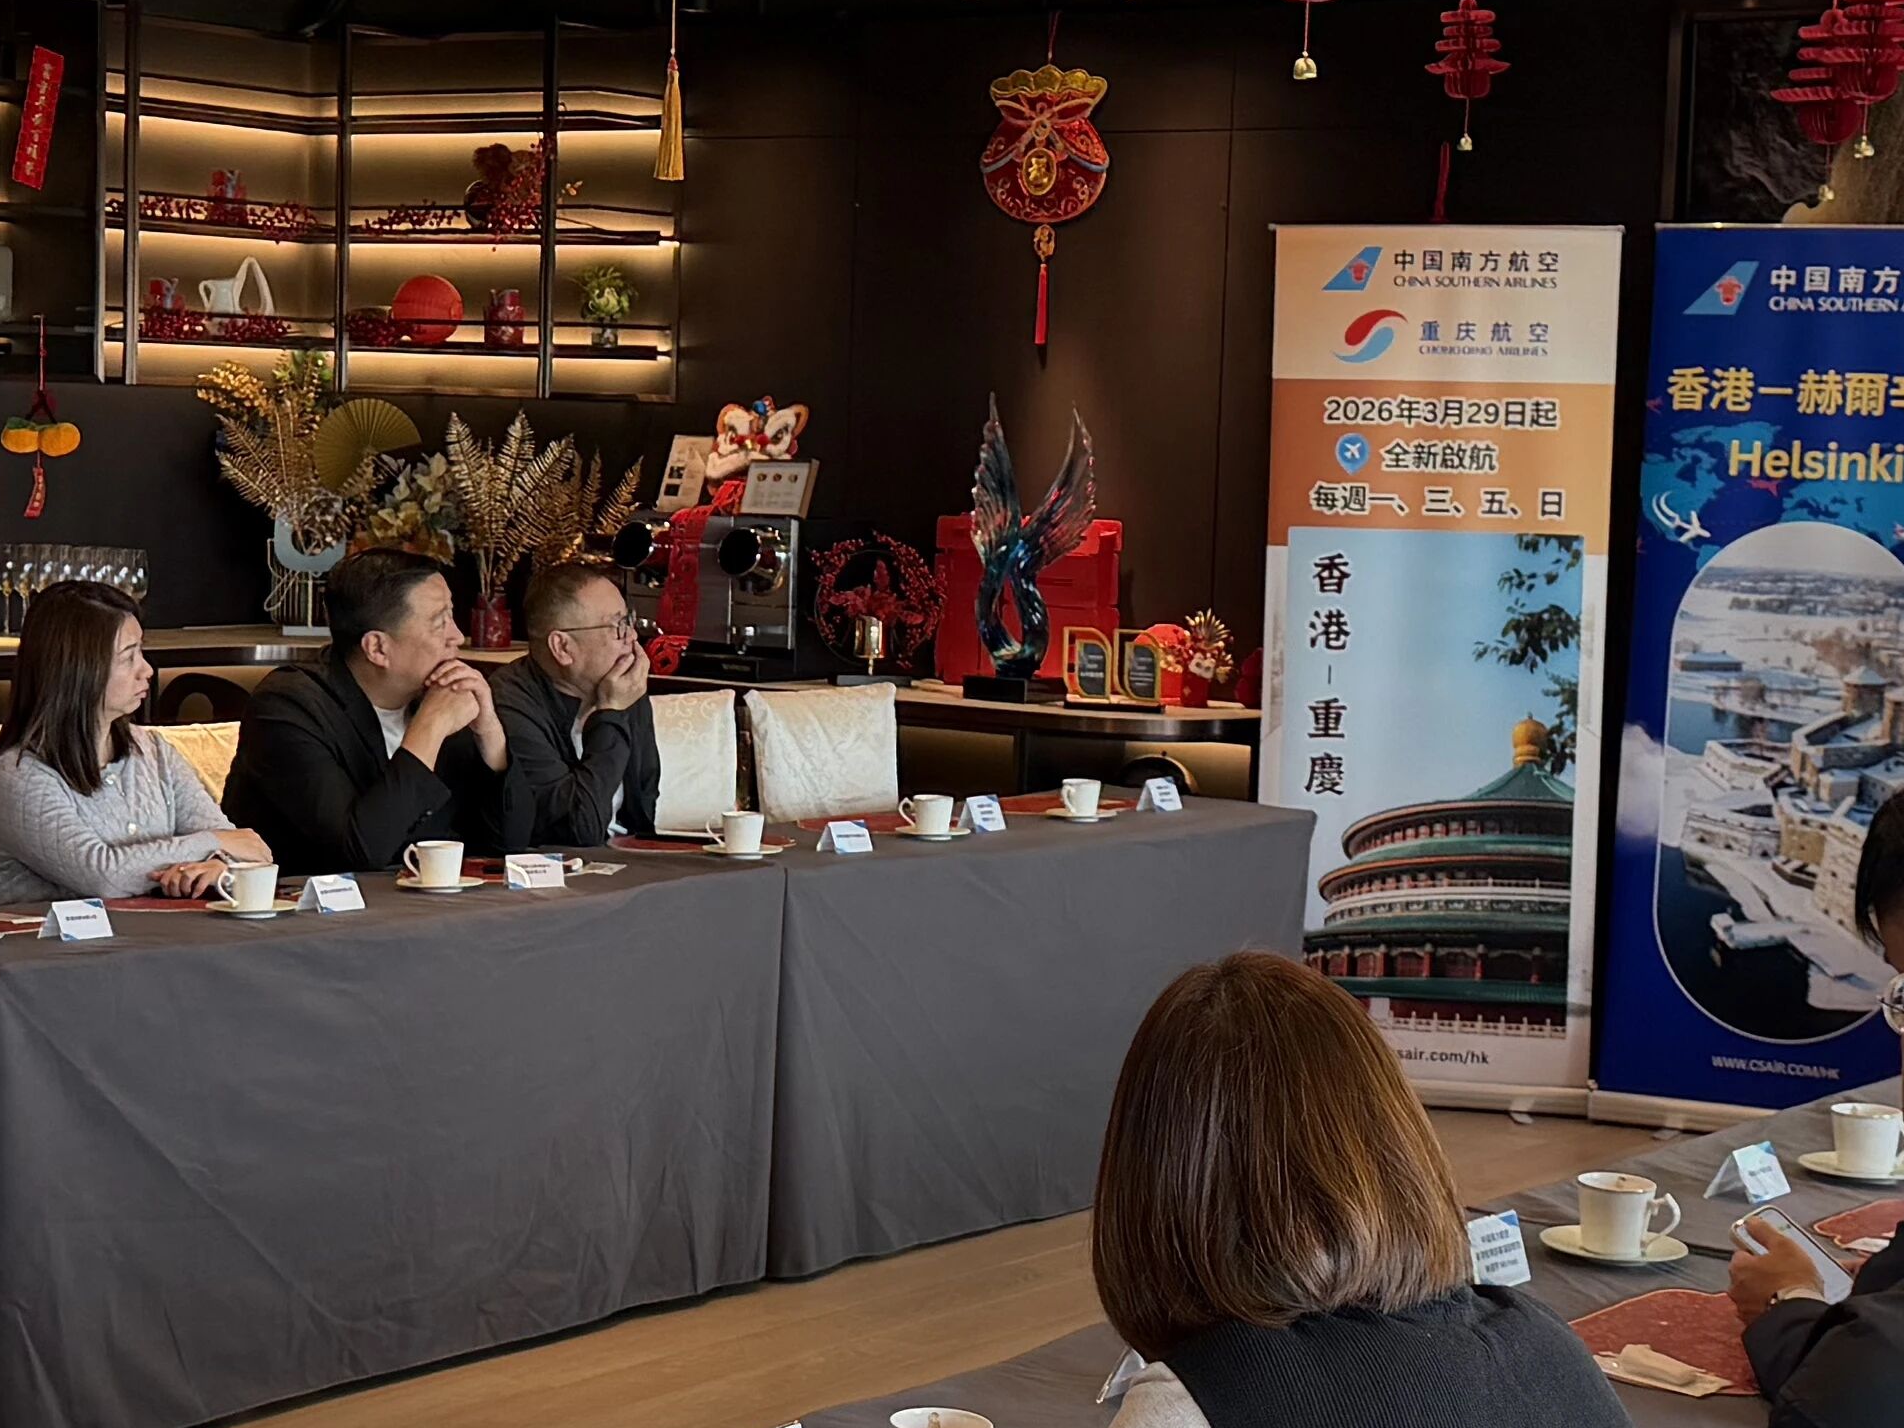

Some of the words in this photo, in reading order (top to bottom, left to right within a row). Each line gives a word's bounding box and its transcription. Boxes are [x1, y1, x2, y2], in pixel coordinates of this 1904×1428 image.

[1394, 250, 1559, 273] 中国南方航空
[1393, 275, 1432, 288] CHINA
[1435, 276, 1501, 289] SOUTHERN
[1504, 277, 1558, 290] AIRLINES
[1768, 295, 1815, 312] CHINA
[1817, 297, 1899, 313] SOUTHERN
[1420, 320, 1550, 343] 重庆航空
[1324, 398, 1559, 429] 2026年3月29日起
